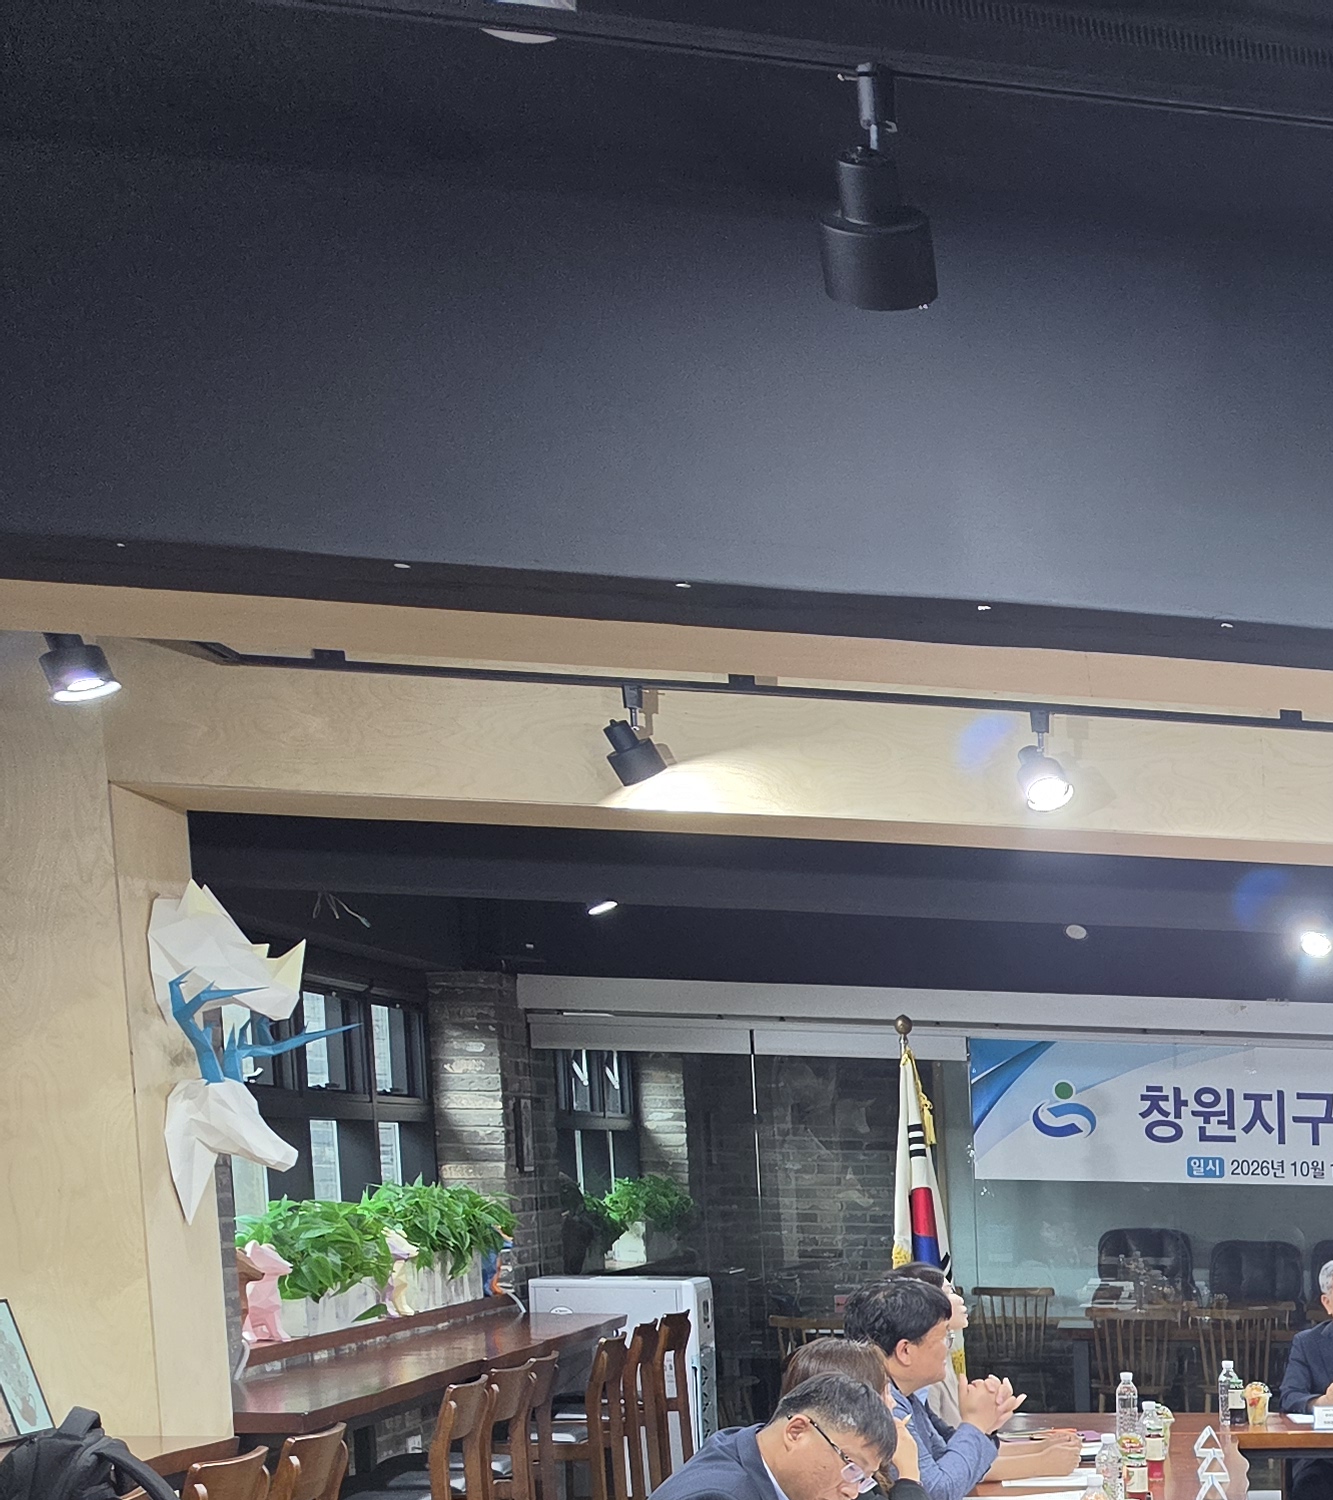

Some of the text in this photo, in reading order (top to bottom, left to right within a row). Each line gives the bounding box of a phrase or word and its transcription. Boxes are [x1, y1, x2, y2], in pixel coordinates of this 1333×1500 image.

[1190, 1158, 1220, 1177] 일시
[1230, 1160, 1285, 1179] 2026년
[1290, 1161, 1326, 1180] 10월
